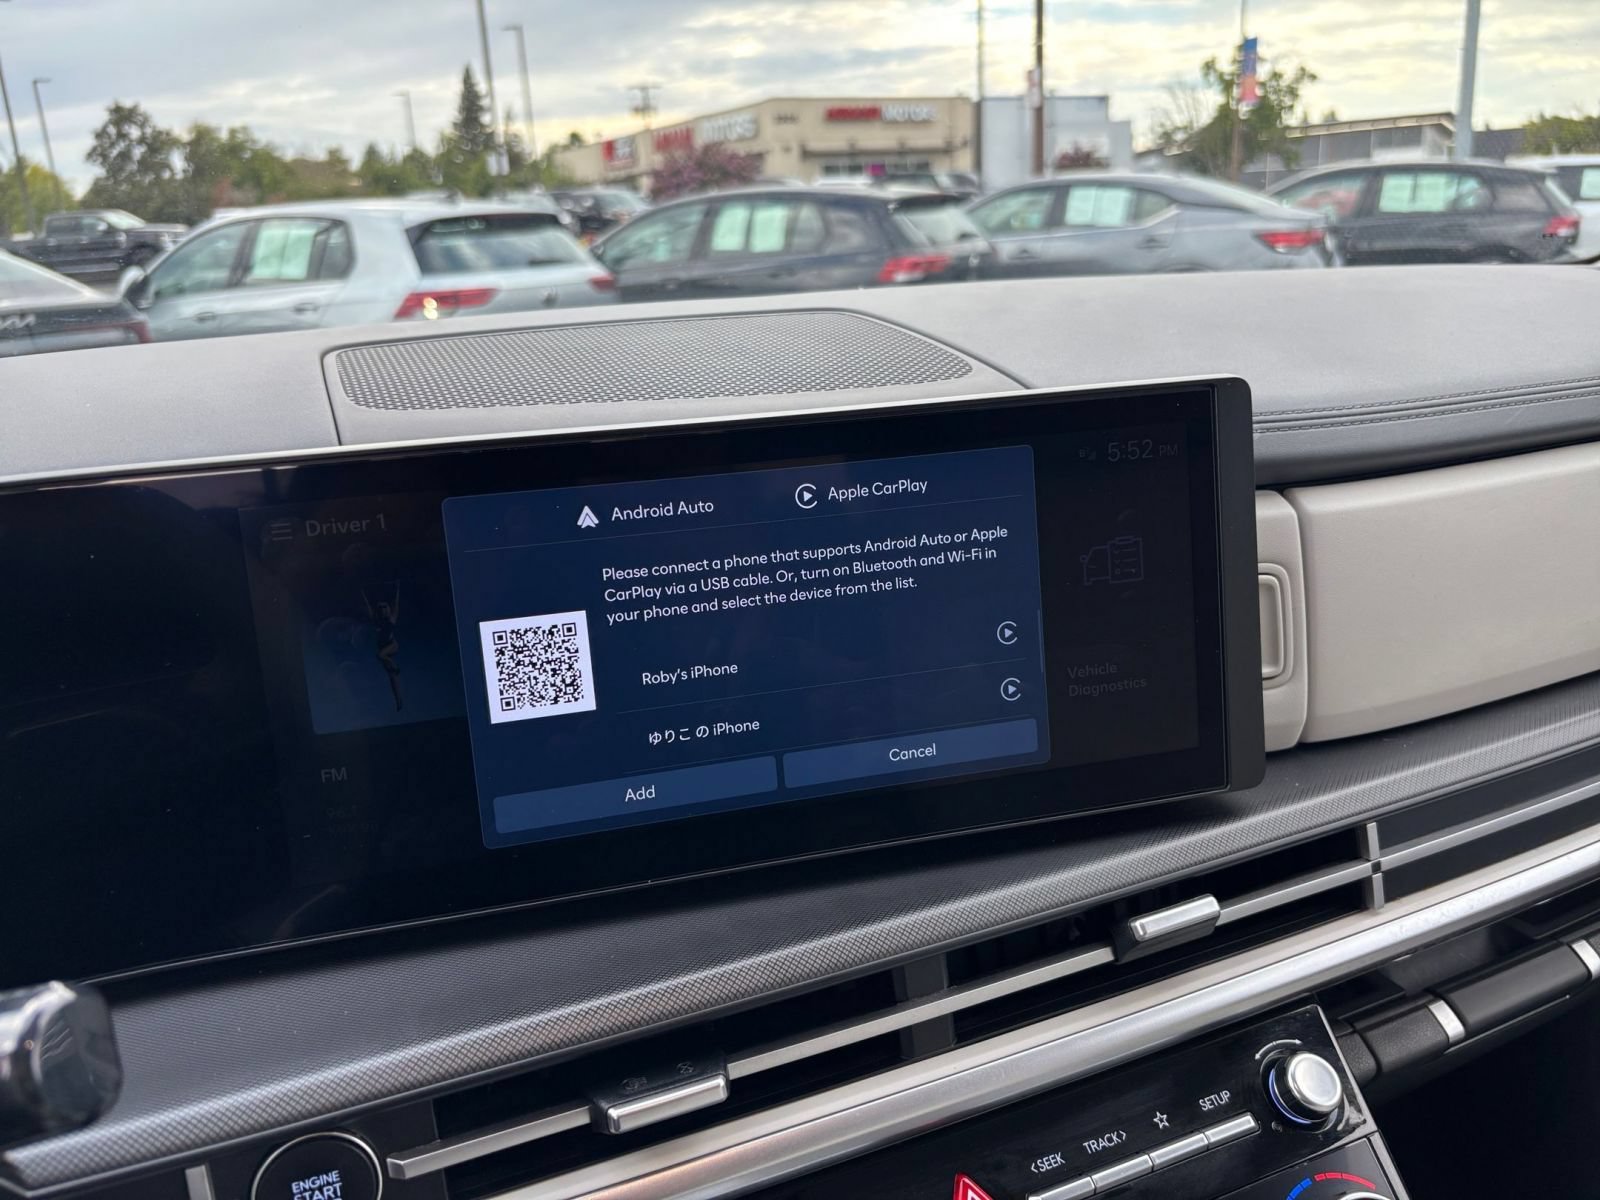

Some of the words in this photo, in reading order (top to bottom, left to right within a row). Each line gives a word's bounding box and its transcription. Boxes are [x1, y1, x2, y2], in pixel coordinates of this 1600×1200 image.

[1107, 438, 1153, 462] 5:52
[1159, 443, 1179, 457] PM
[828, 484, 870, 503] Apple
[872, 478, 928, 497] CarPlay
[611, 502, 674, 522] Android
[677, 499, 714, 516] Auto
[305, 517, 371, 537] Driver
[376, 513, 386, 530] 1
[602, 567, 649, 581] Please
[651, 559, 710, 577] connect
[712, 560, 721, 570] a
[724, 555, 768, 571] phone
[770, 550, 800, 563] that
[802, 543, 862, 561] supports
[864, 535, 917, 553] Android
[919, 533, 952, 547] Auto
[953, 533, 969, 543] or
[970, 526, 1008, 543] Apple
[604, 585, 662, 602] CarPlay
[664, 582, 686, 596] via
[688, 583, 698, 593] a
[701, 576, 730, 591] USB
[732, 572, 774, 588] cable.
[776, 569, 798, 583] Or,
[800, 569, 830, 581] turn
[832, 566, 850, 577] on
[853, 555, 917, 575] Bluetooth
[919, 552, 945, 567] and
[946, 547, 982, 563] Wi-Fi
[984, 547, 997, 560] in
[606, 609, 641, 626] your
[643, 604, 689, 622] phone
[691, 598, 719, 613] and
[721, 595, 762, 610] select
[764, 591, 787, 605] the
[789, 587, 833, 602] device
[835, 583, 868, 597] from
[870, 579, 893, 592] the
[895, 576, 918, 590] list.
[641, 668, 688, 686] Roby's
[690, 663, 739, 680] iPhone
[1067, 662, 1118, 679] Vehicle
[1068, 677, 1147, 697] Diagnostics
[712, 720, 760, 738] iPhone
[888, 743, 937, 762] Cancel
[320, 767, 349, 784] FM
[624, 785, 656, 803] Add
[1199, 1090, 1232, 1112] SETUP
[291, 1170, 341, 1194] ENGINE
